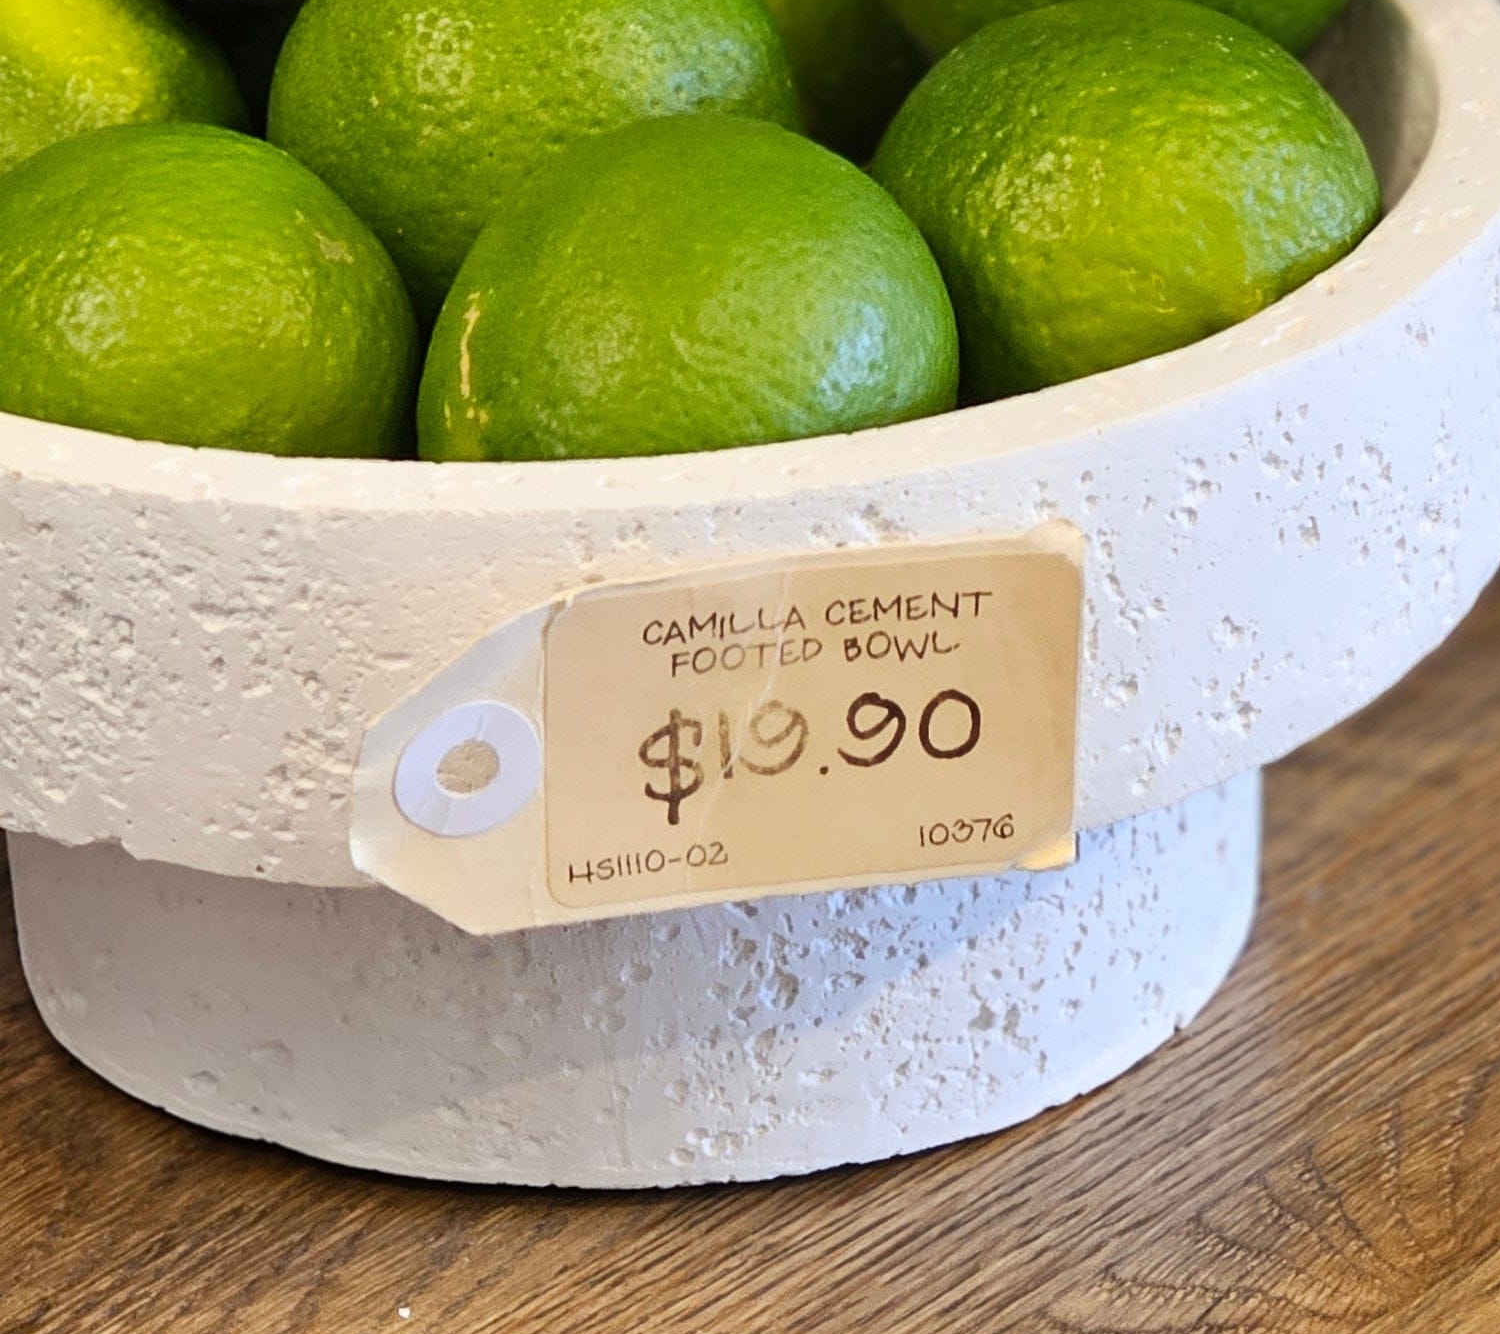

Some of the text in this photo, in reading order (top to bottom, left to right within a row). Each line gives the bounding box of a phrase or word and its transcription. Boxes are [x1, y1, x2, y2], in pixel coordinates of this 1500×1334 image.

[642, 590, 993, 647] CAMILLA CEMENT
[669, 630, 960, 677] FOOTED BOWL
[638, 689, 982, 825] $19.90
[918, 813, 1015, 848] 10376
